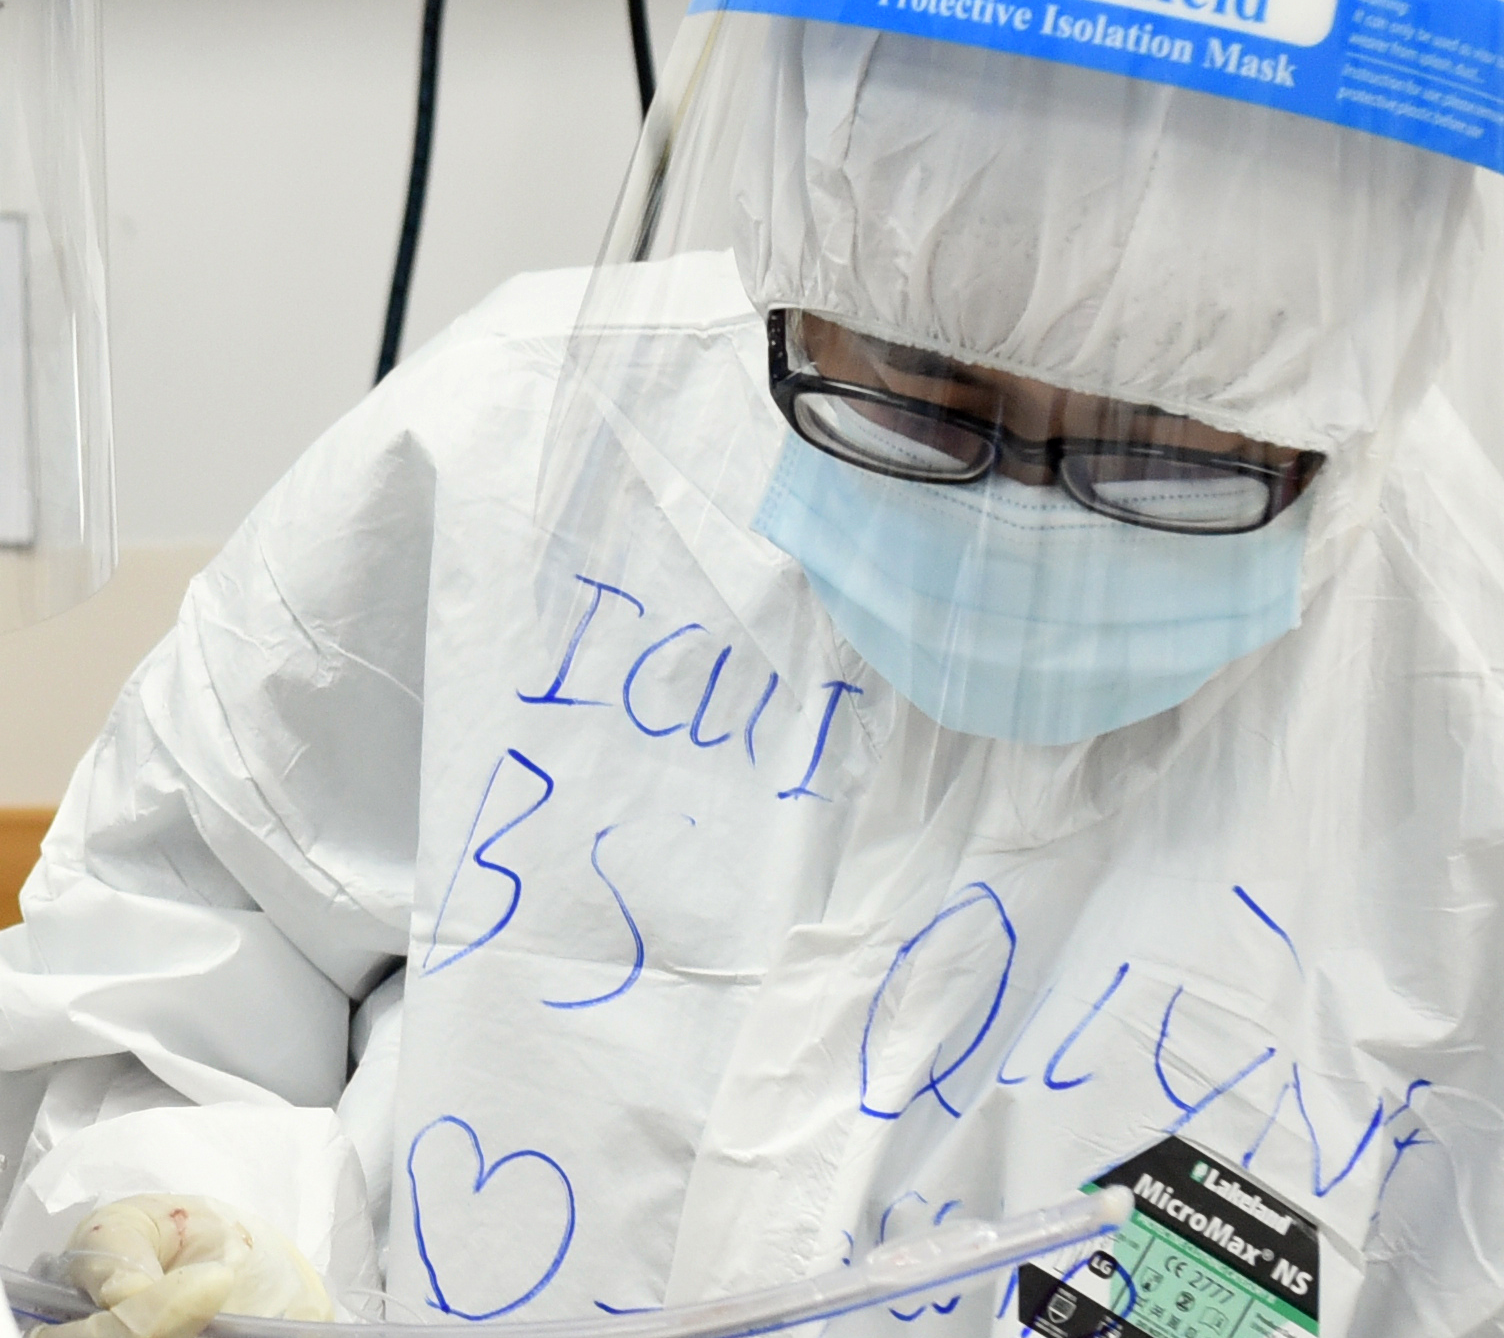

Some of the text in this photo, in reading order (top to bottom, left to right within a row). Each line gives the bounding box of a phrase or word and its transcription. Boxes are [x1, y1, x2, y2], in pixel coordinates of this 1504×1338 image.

[1041, 5, 1195, 64] Isolation
[1203, 37, 1298, 88] Mask
[418, 748, 696, 1009] BS
[1203, 1168, 1295, 1236] Lakeland
[1091, 1254, 1114, 1275] LG
[1189, 1270, 1236, 1305] 2777
[1269, 1257, 1313, 1297] NS
